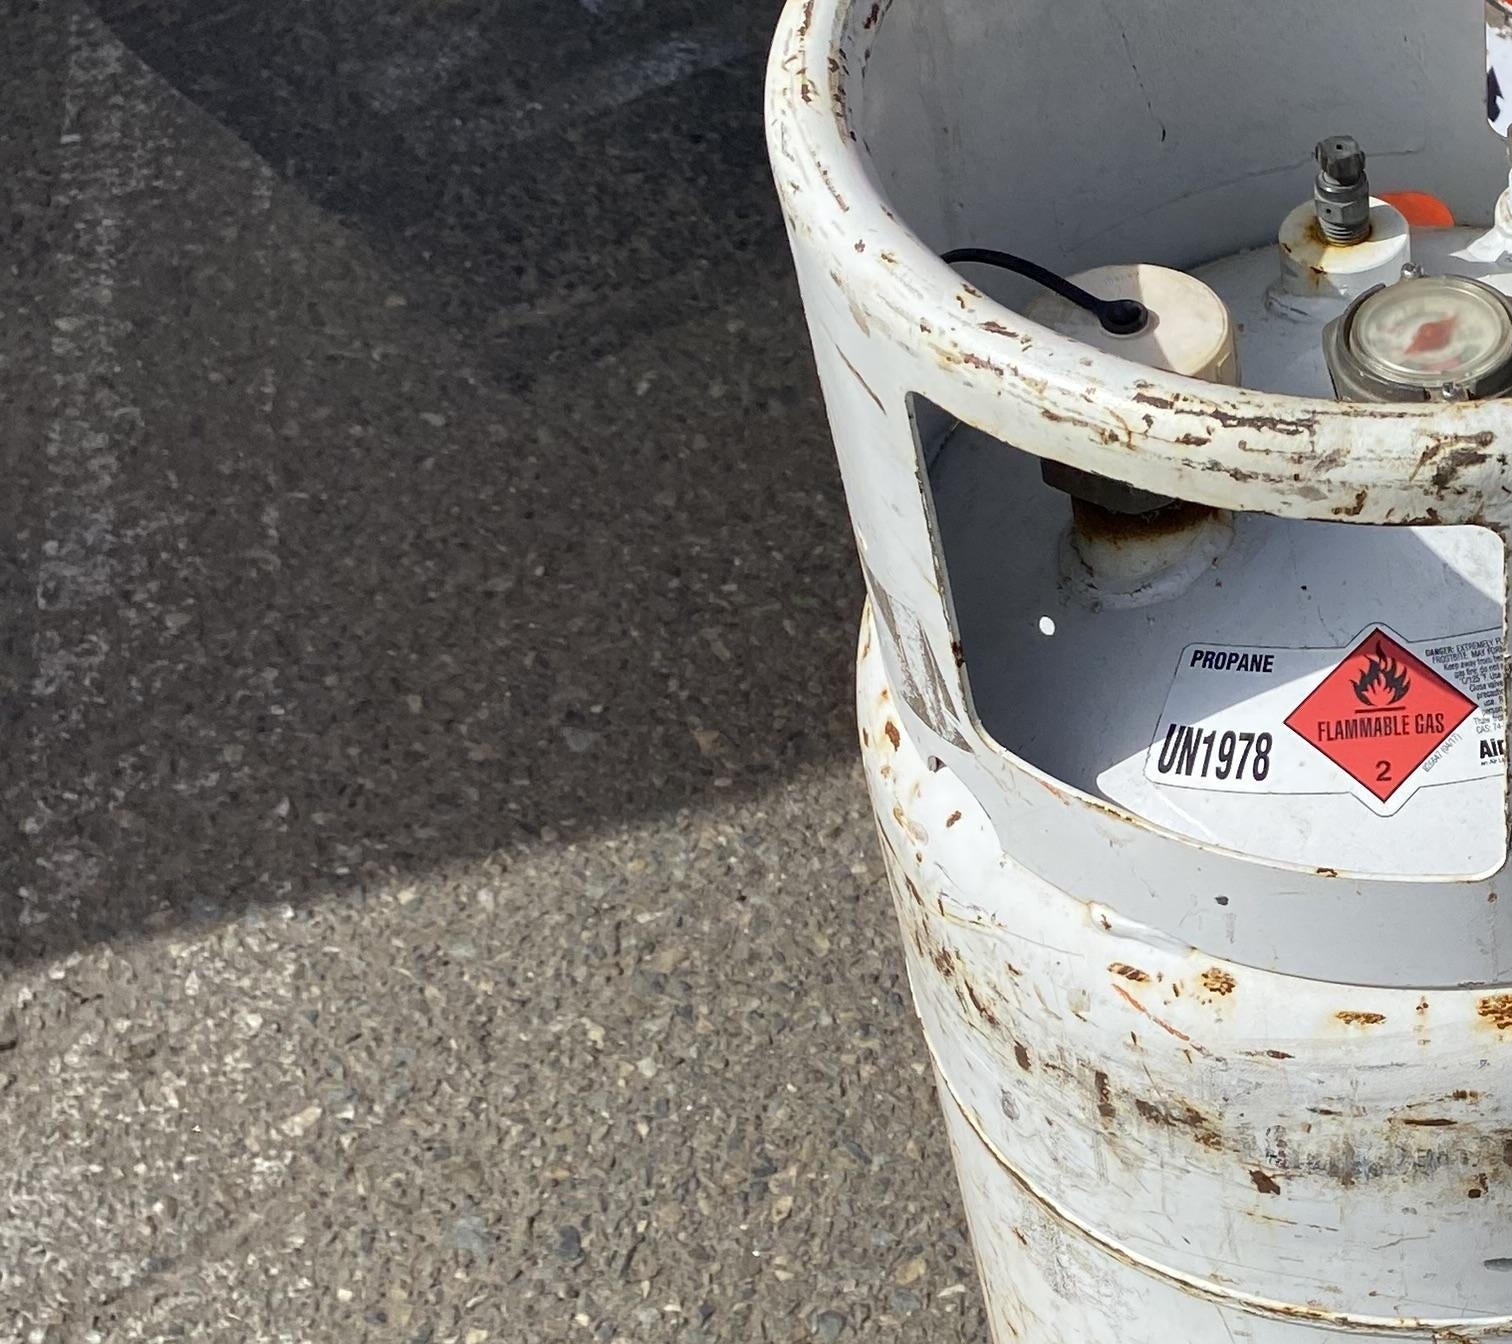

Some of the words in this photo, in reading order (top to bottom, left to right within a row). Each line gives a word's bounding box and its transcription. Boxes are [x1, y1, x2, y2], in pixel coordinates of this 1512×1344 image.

[1190, 649, 1275, 673] PROPANE
[1316, 715, 1410, 742] FLAMMABLE
[1414, 712, 1445, 735] GAS
[1156, 723, 1274, 783] UN1978
[1375, 760, 1393, 783] 2
